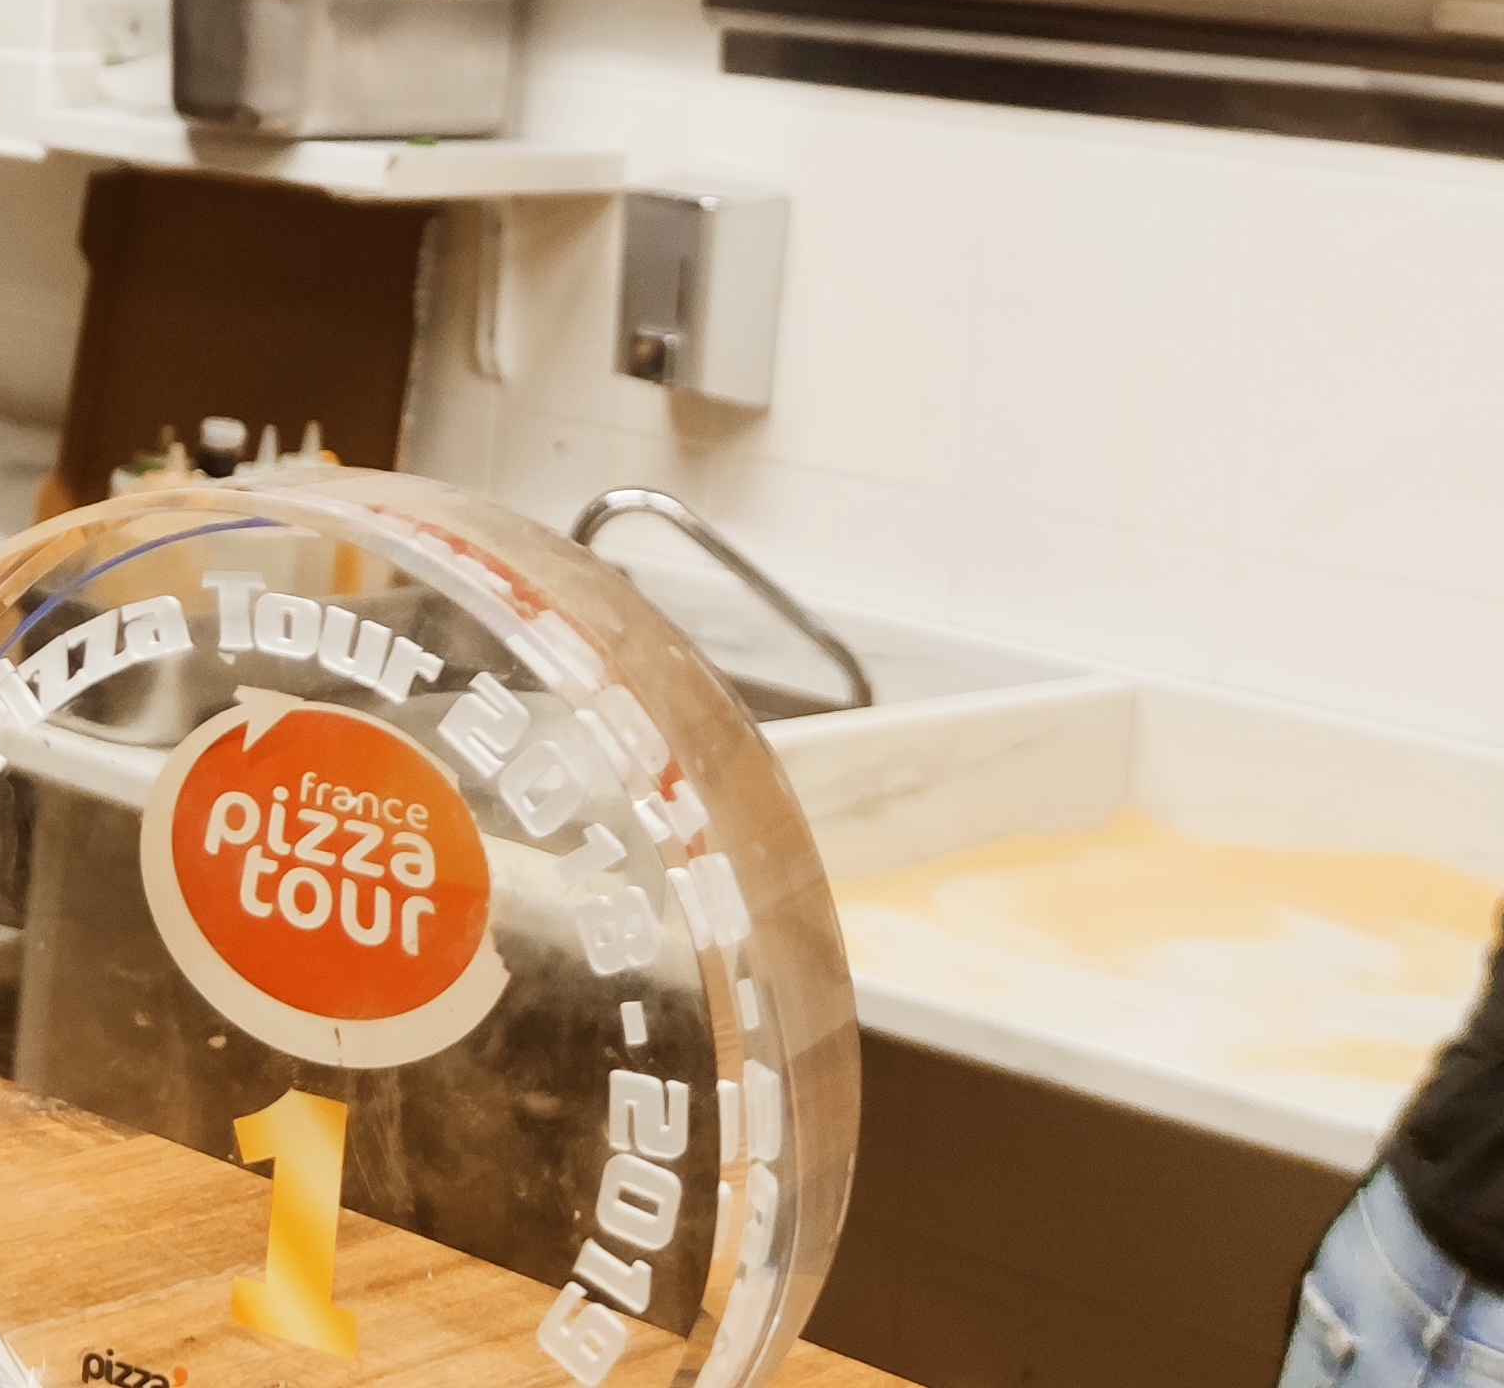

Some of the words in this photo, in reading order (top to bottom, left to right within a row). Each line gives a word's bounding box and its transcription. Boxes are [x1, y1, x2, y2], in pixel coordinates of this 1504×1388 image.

[203, 569, 445, 703] Tour
[203, 784, 438, 890] pizza
[299, 770, 432, 832] france
[438, 670, 660, 977] 2018
[239, 852, 436, 956] tour
[232, 1086, 359, 1360] 1
[537, 1068, 690, 1388] 2019
